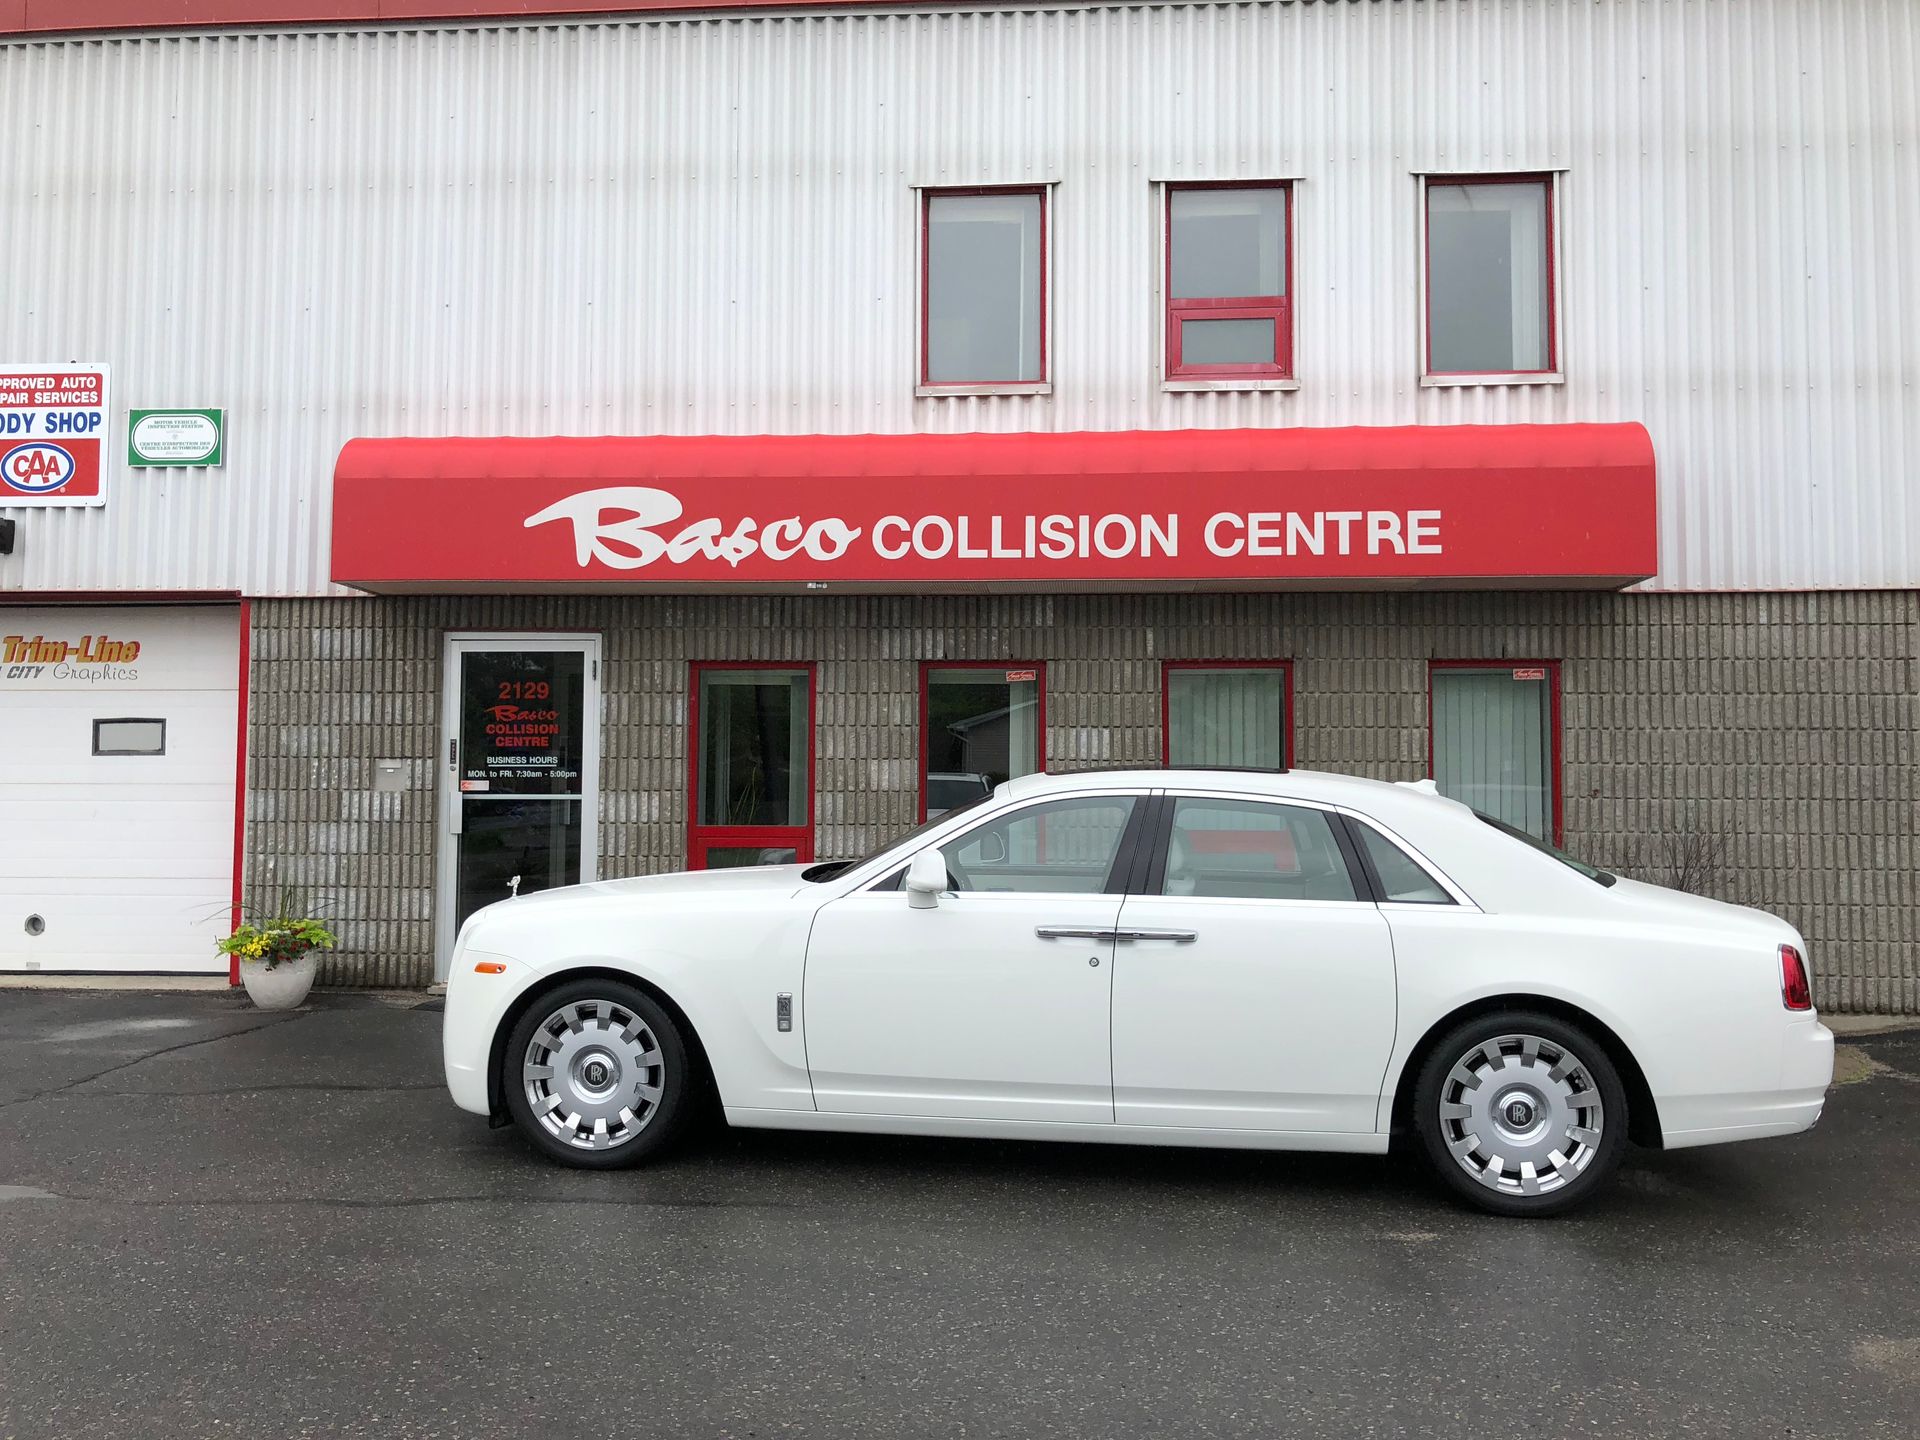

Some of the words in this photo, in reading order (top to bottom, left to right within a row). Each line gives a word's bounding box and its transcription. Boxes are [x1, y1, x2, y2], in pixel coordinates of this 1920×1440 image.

[61, 376, 97, 389] AUTO
[34, 391, 98, 404] SERVICES
[45, 411, 102, 433] SHOP
[13, 450, 61, 484] CAA
[524, 486, 862, 570] Basco
[872, 514, 1178, 561] COLLISION
[1203, 510, 1443, 556] CENTRE
[2, 635, 141, 663] Trim-Line
[6, 666, 45, 679] CITY
[53, 663, 138, 683] Graphics
[499, 682, 550, 700] 2129
[484, 705, 559, 721] Basco
[485, 724, 560, 735] COLLISION
[495, 737, 549, 747] CENTRE
[486, 756, 527, 764] BUSINESS
[529, 756, 558, 764] HOURS
[467, 770, 487, 778] MON.
[490, 770, 497, 778] to
[499, 770, 514, 778] FRI.
[516, 770, 543, 778] 7:30am
[550, 770, 577, 779] 5:00pm
